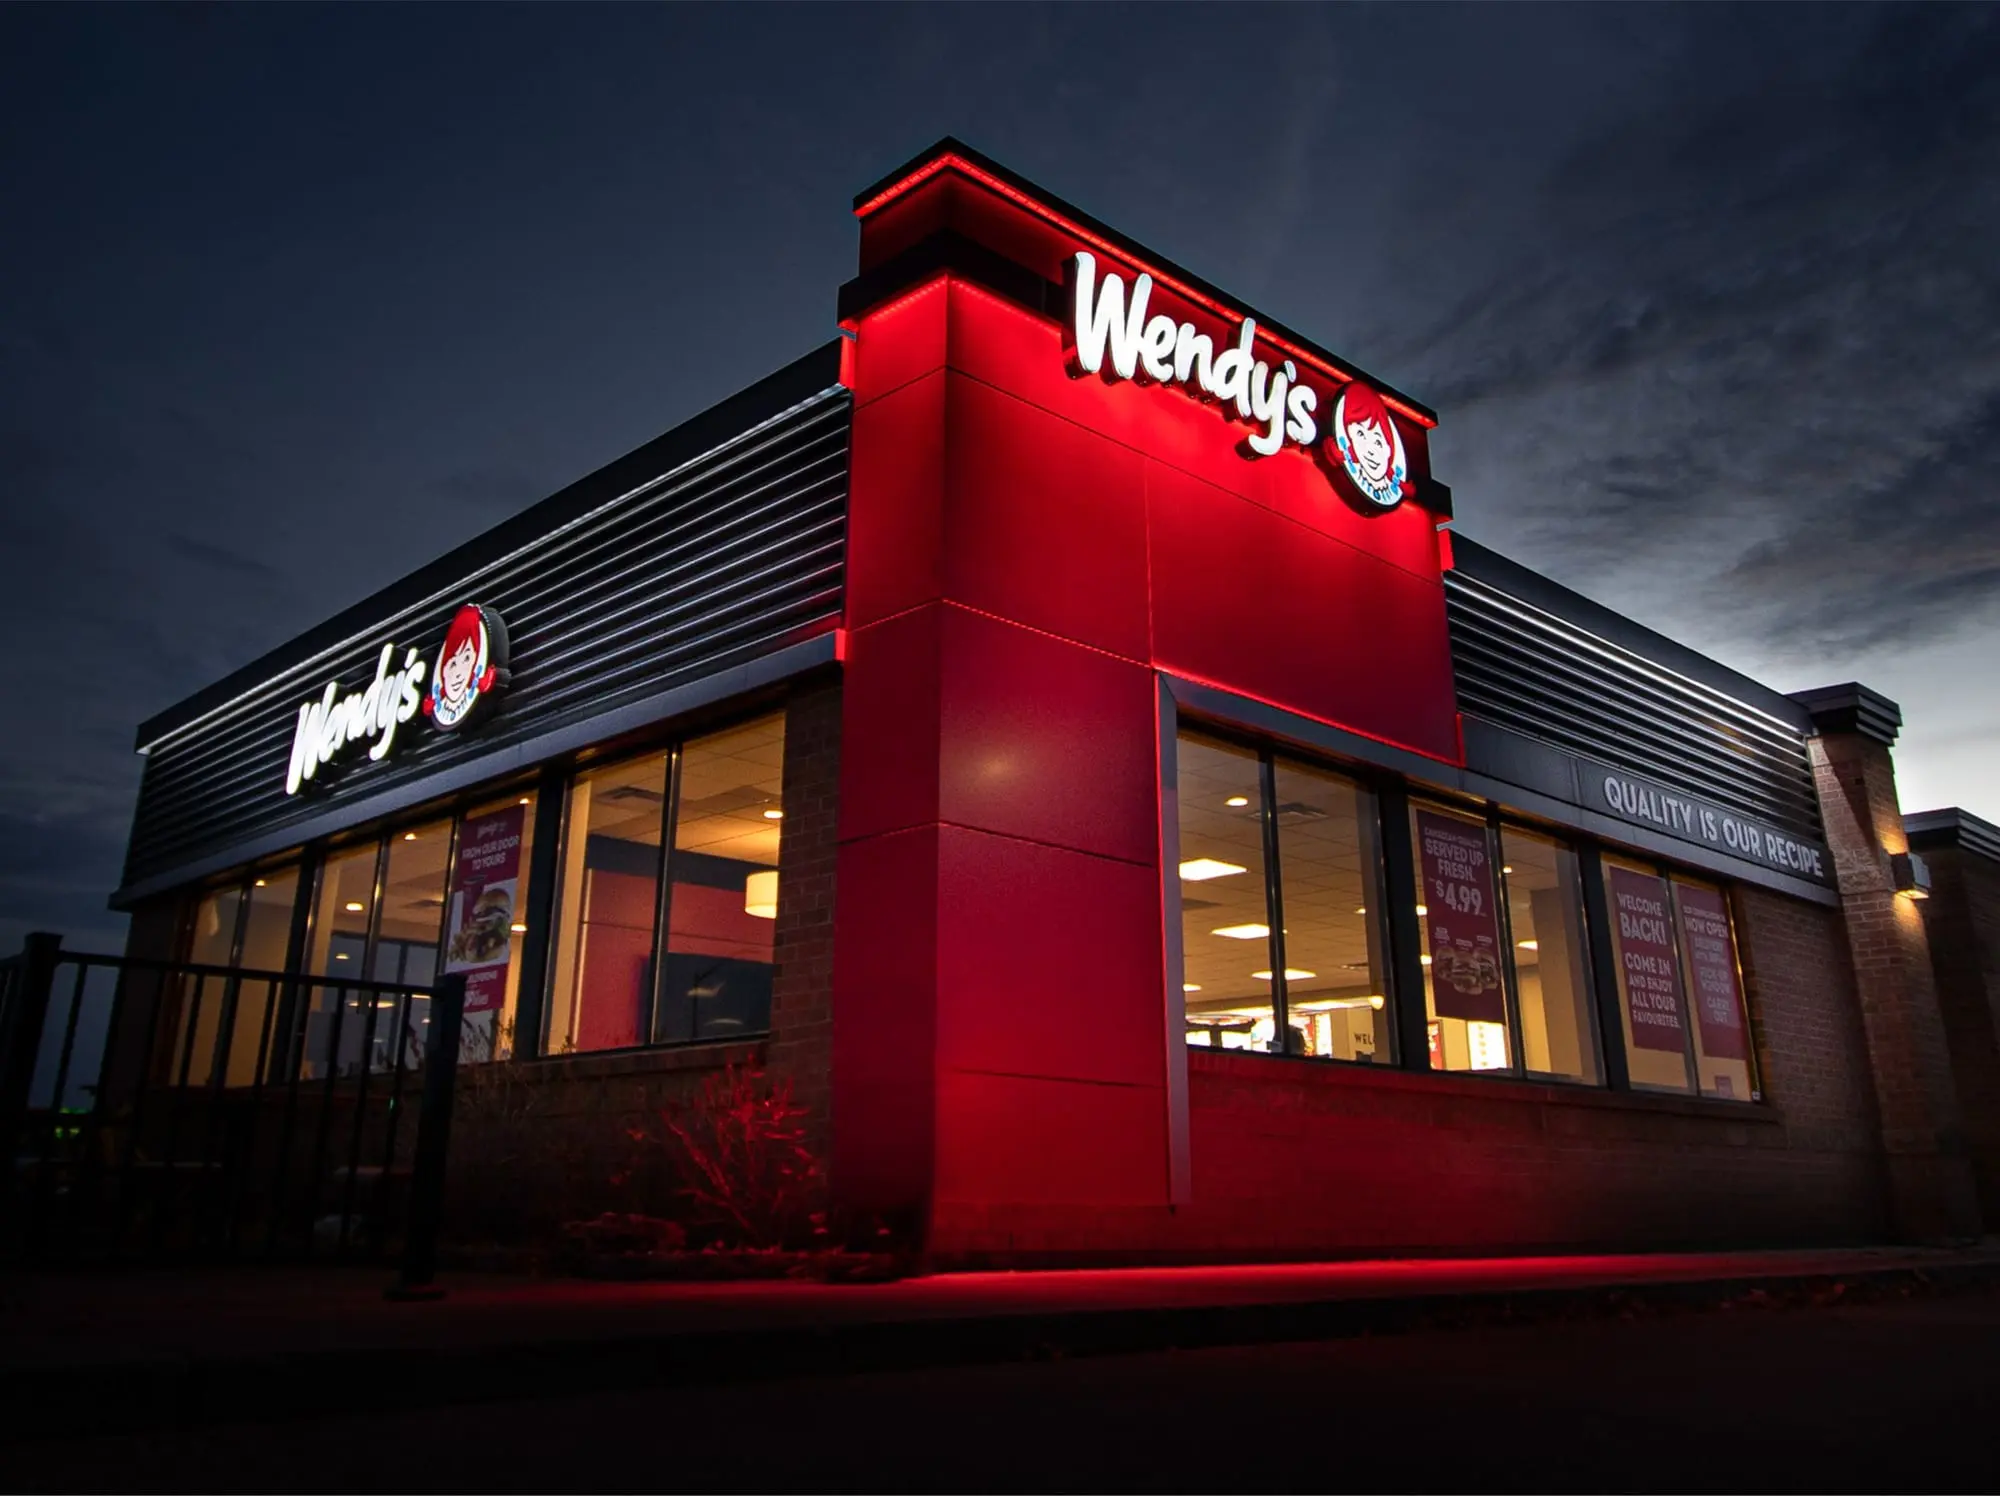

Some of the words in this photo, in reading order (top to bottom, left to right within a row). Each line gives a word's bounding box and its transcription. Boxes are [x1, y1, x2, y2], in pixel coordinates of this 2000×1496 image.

[1075, 251, 1317, 456] Wendy's
[286, 643, 426, 794] Wendy's
[1604, 776, 1692, 833] QUALITY
[1700, 804, 1718, 841] IS
[1722, 818, 1762, 857] OUR
[1764, 833, 1824, 877] RECIPE
[482, 841, 497, 855] OUR
[498, 835, 520, 851] DOOR
[1425, 838, 1468, 862] SERVED
[1469, 849, 1484, 868] UP
[472, 859, 481, 871] TO
[482, 851, 506, 869] YOURS
[1435, 879, 1483, 915] $4.99
[1618, 893, 1662, 917] WELCOME
[1620, 912, 1667, 945] BACK!
[1684, 916, 1705, 932] NOW
[1706, 921, 1729, 938] OPEN
[1624, 952, 1657, 975] COME
[1658, 959, 1672, 976] IN
[1629, 975, 1646, 988] AND
[1647, 979, 1673, 993] ENJOY
[1631, 991, 1649, 1009] ALL
[1649, 993, 1676, 1012] YOUR
[1354, 1032, 1376, 1045] WEL
